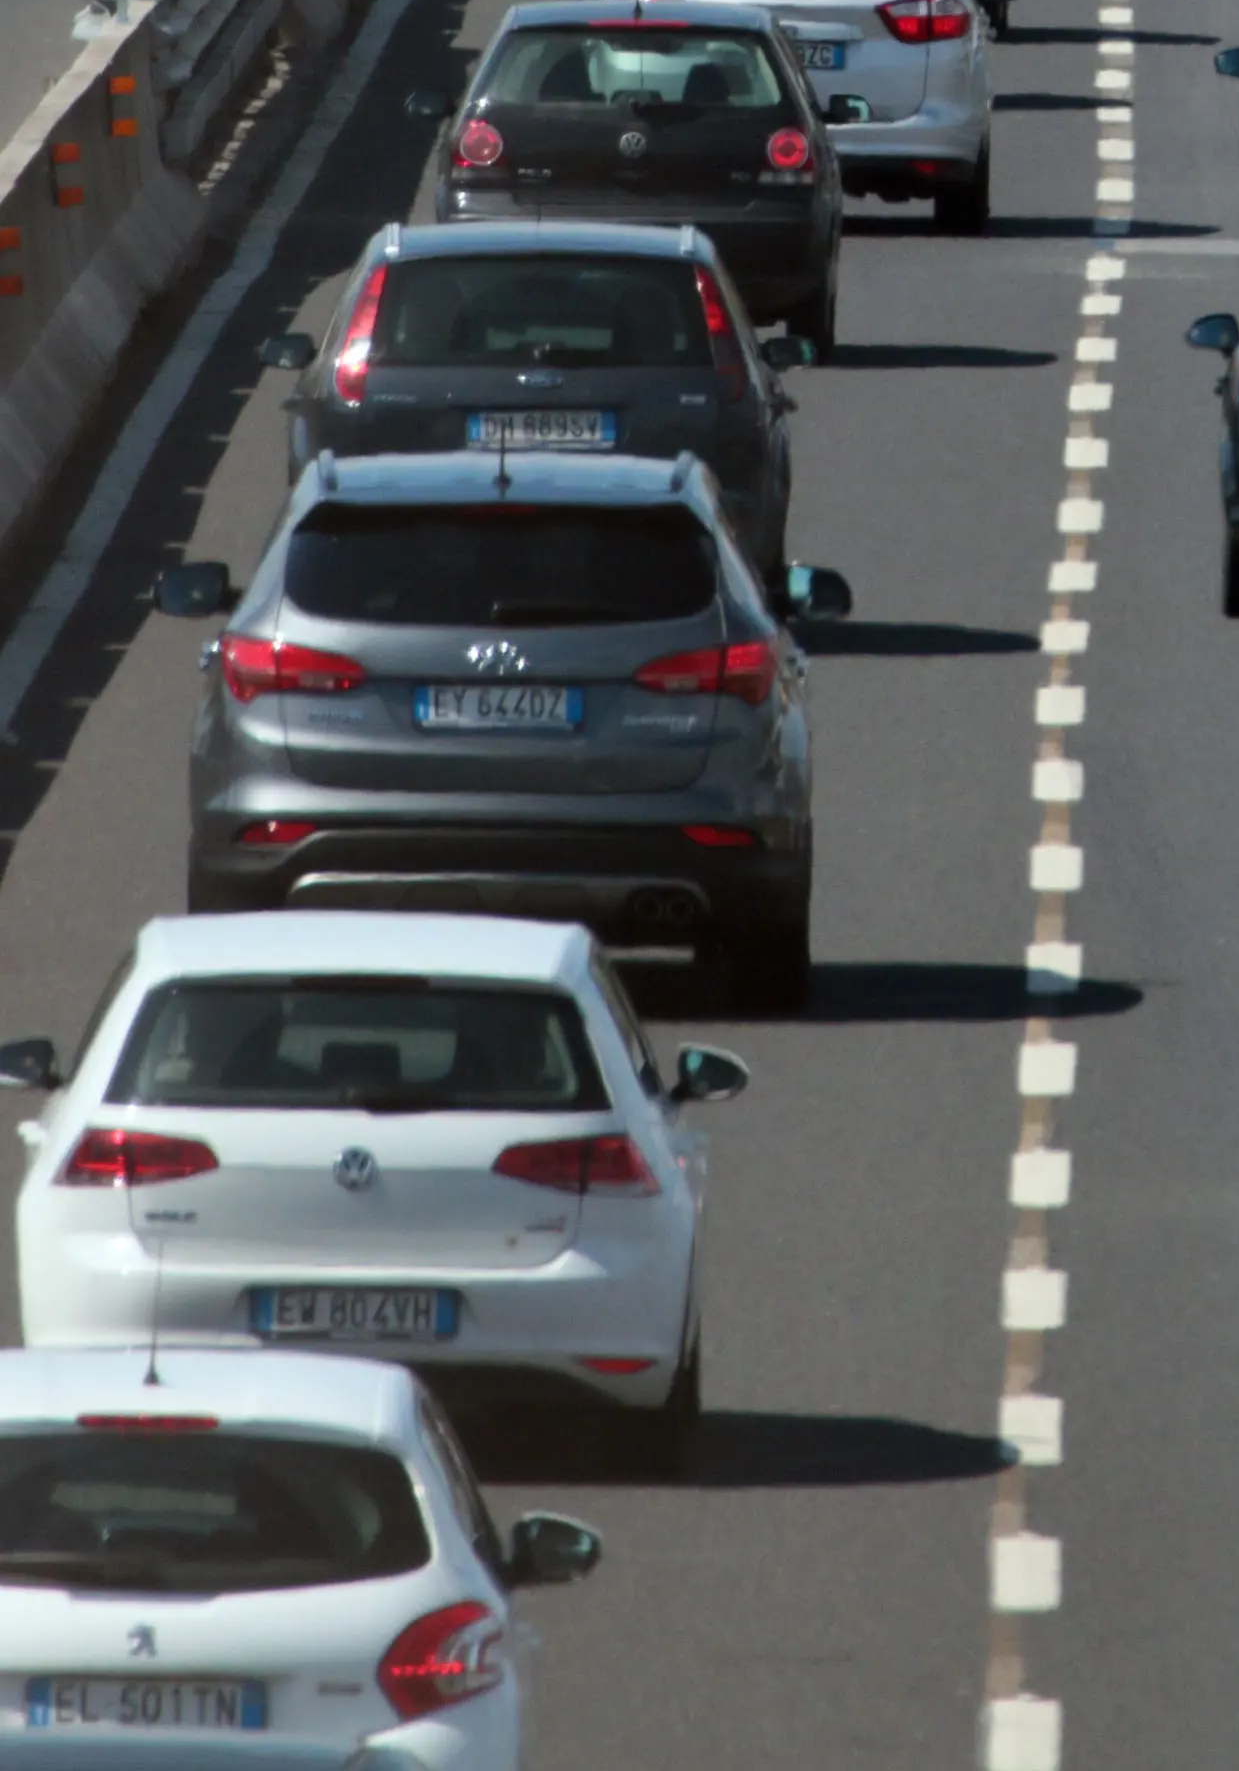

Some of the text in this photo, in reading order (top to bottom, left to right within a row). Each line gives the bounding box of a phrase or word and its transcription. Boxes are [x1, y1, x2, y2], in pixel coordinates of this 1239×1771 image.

[330, 1290, 432, 1329] 804VH
[56, 1683, 237, 1727] EL 501TN
